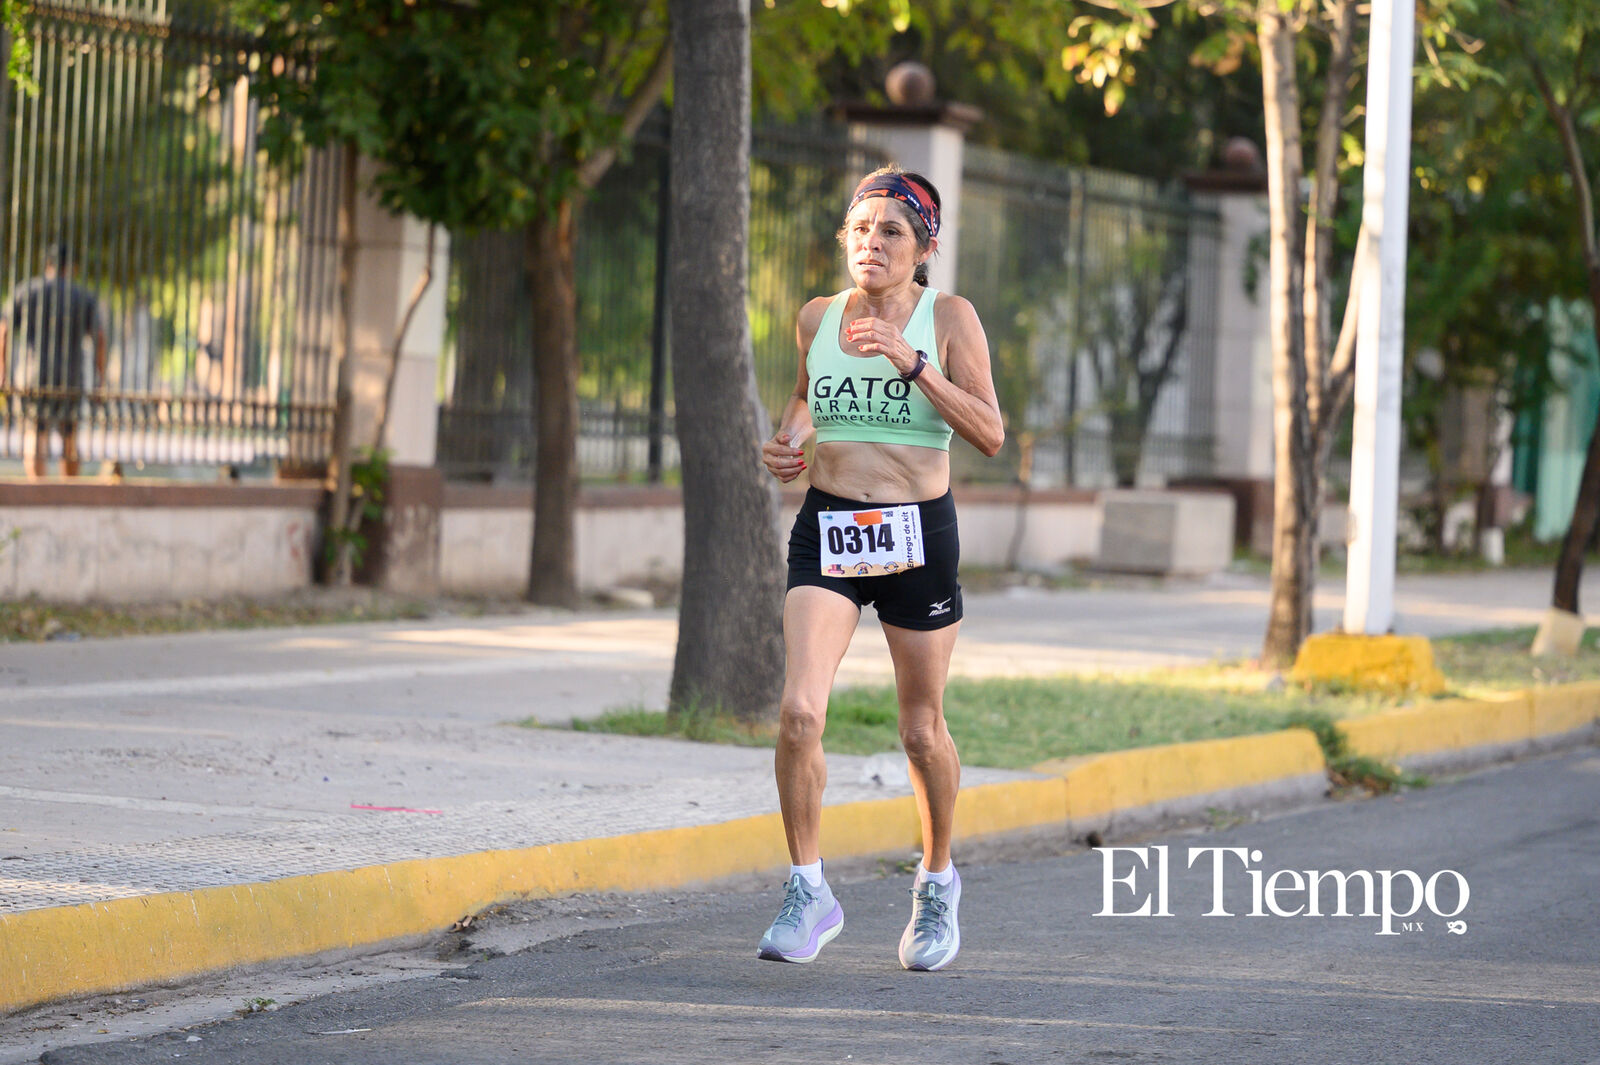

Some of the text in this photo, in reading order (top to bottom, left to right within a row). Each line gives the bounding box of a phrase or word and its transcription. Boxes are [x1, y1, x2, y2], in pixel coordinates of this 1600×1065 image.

[814, 399, 911, 415] ARAIZA
[817, 414, 911, 424] runnersclub
[901, 511, 910, 522] kit
[903, 524, 911, 535] de
[827, 523, 895, 555] 0314
[904, 536, 914, 568] Entrega
